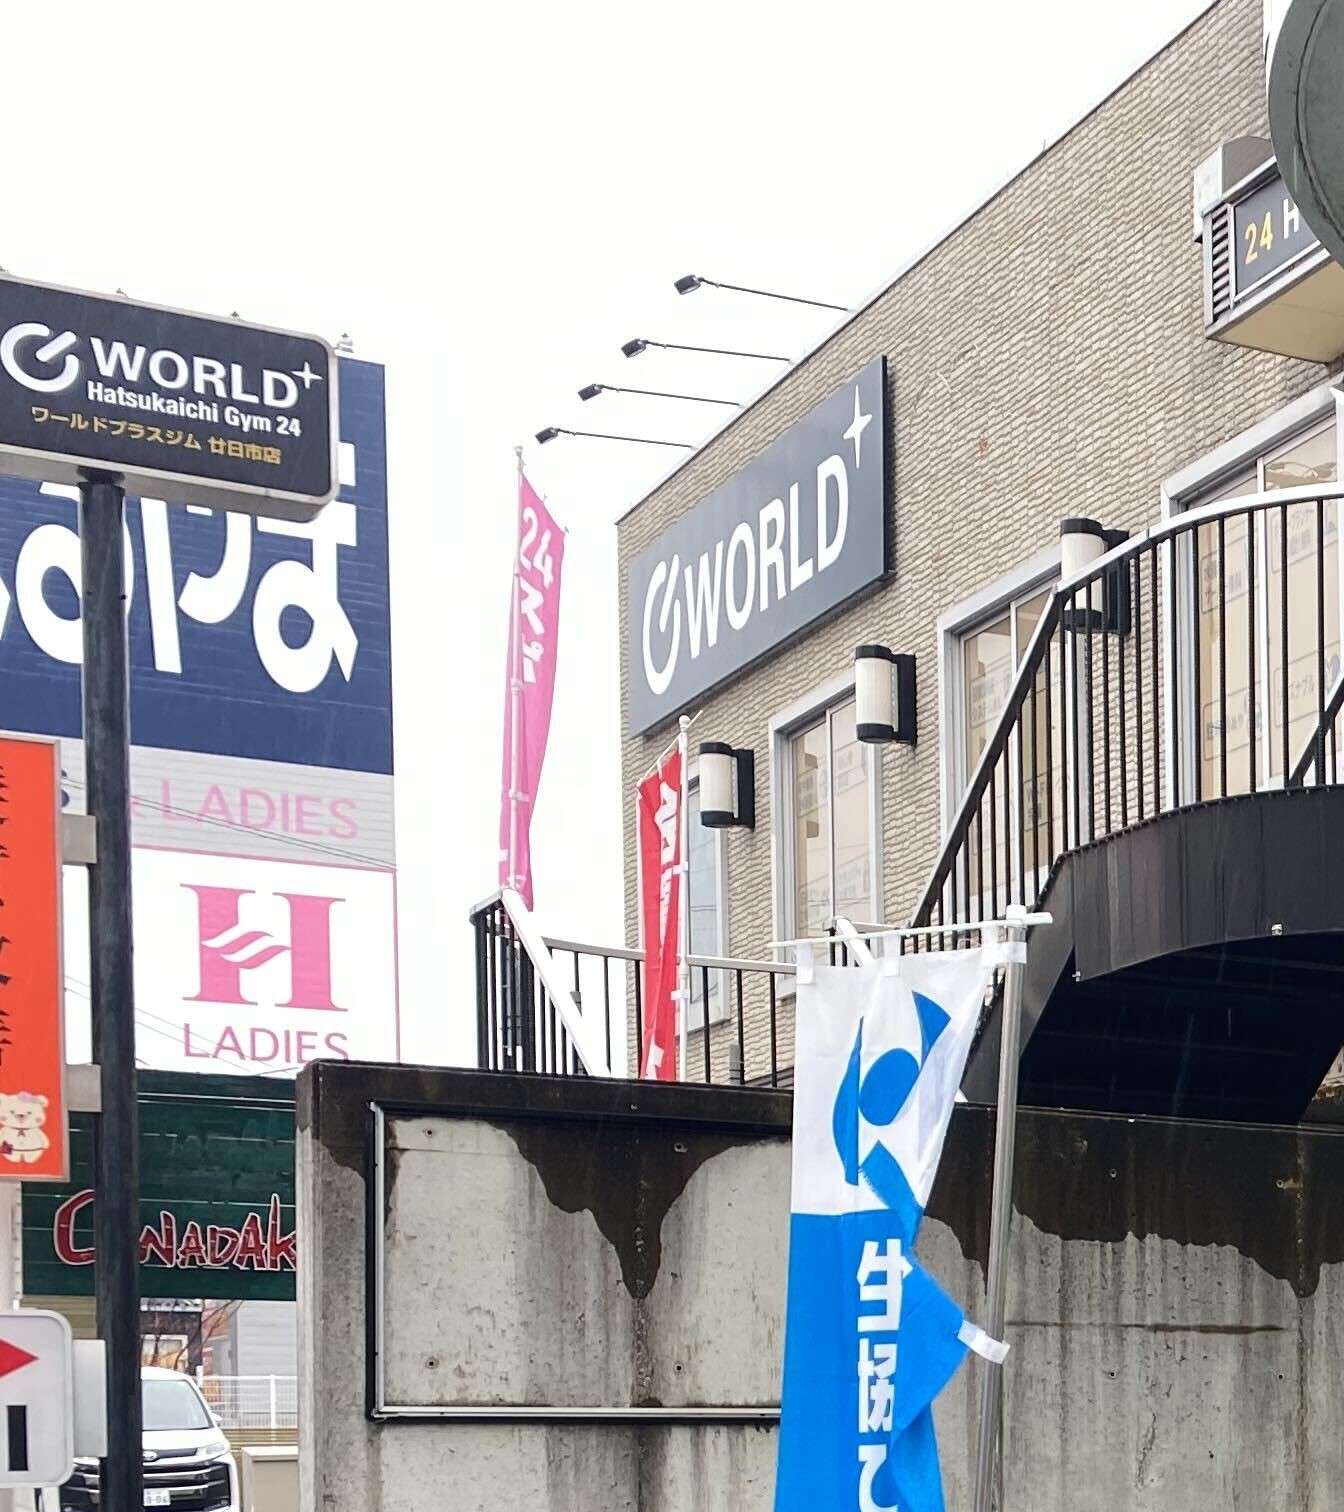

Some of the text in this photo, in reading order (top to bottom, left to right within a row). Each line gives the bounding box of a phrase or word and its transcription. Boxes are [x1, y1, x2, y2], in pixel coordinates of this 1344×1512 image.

[1244, 210, 1273, 265] 24
[31, 406, 281, 465] ワールドプラスジム 廿日市店
[87, 380, 302, 437] Hatsukaichi Gym 24
[161, 778, 359, 840] LADIES
[183, 1022, 349, 1062] LADIES
